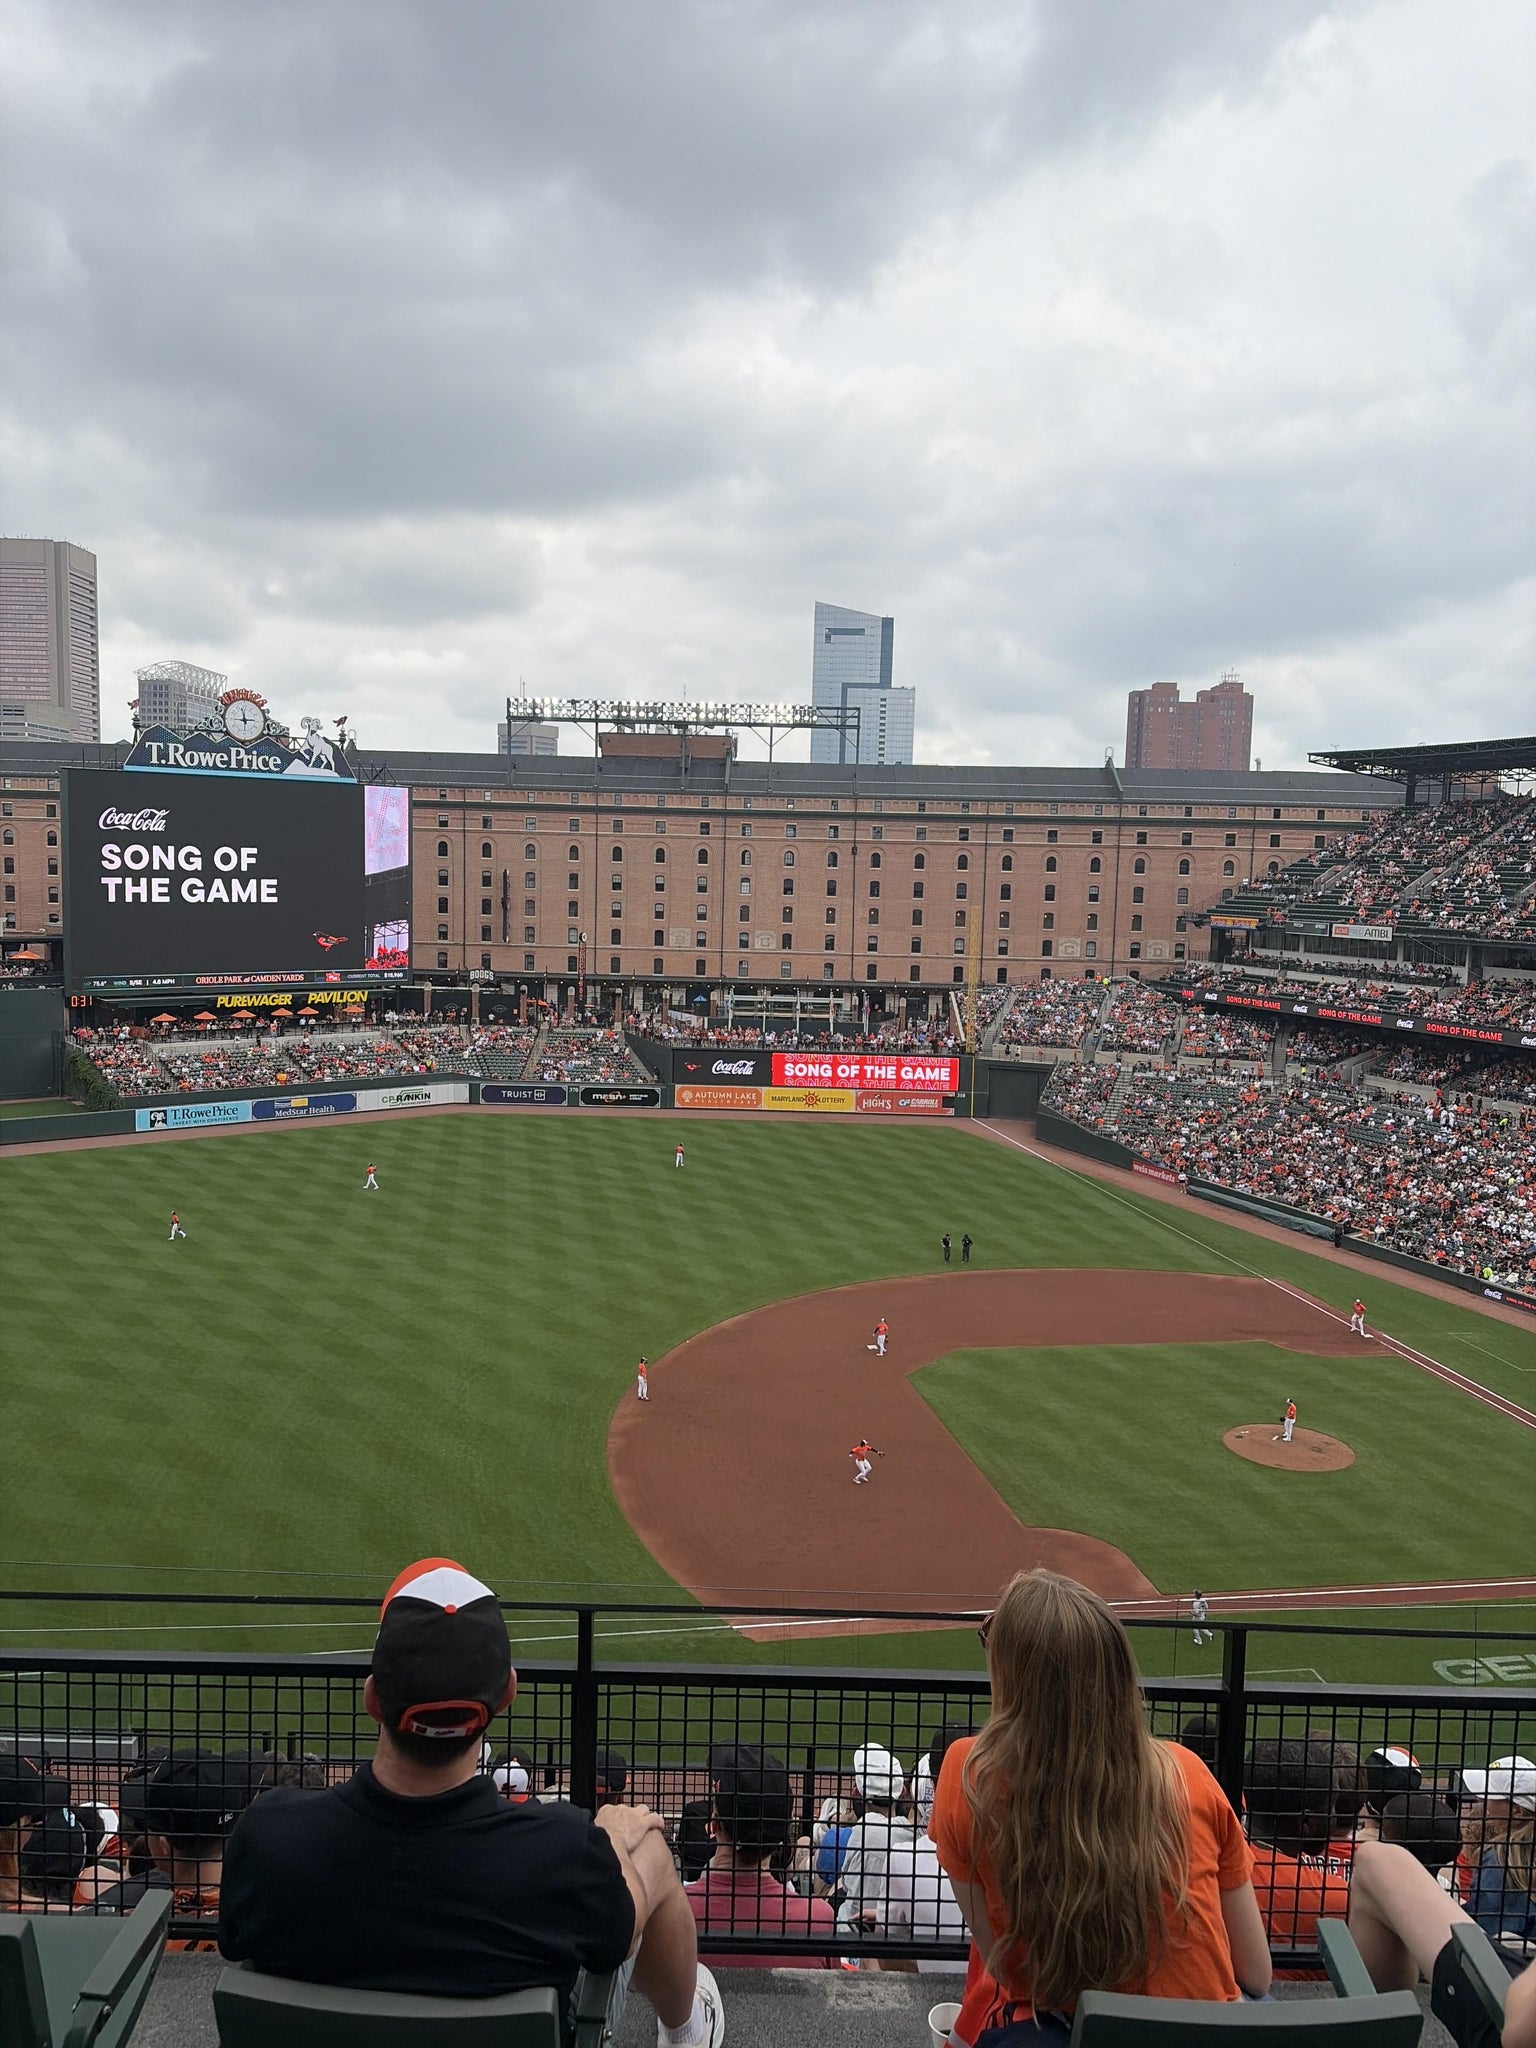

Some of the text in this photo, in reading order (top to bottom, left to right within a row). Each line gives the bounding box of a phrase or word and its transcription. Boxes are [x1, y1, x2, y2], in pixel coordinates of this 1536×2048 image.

[229, 747, 282, 772] Price
[98, 806, 171, 832] Coca-Cola
[101, 843, 258, 872] SONG OF
[100, 877, 279, 903] THE GAME
[195, 976, 223, 985] ORIOLE
[223, 975, 243, 984] PARK
[250, 974, 281, 983] CAMDEN
[281, 973, 305, 982] YARDS
[216, 990, 368, 1008] PUREWAGER PAVILION
[1226, 995, 1242, 1004] SONG
[1251, 998, 1264, 1007] THE
[1263, 1000, 1281, 1010] GAME
[1318, 1008, 1382, 1025] SONG OF THE GAME
[1426, 1023, 1504, 1042] SONG OF THE GAME
[711, 1059, 757, 1076] Coca-Cola
[784, 1063, 950, 1082] SONG OF THE GAME
[501, 1090, 533, 1098] TRUIST
[695, 1091, 732, 1099] AUTUMN
[771, 1095, 805, 1103] MARYLAND
[910, 1098, 938, 1106] CARROLL
[212, 1105, 239, 1117] Price
[275, 1104, 335, 1118] MedStar Health
[862, 1098, 892, 1110] HIGH'S
